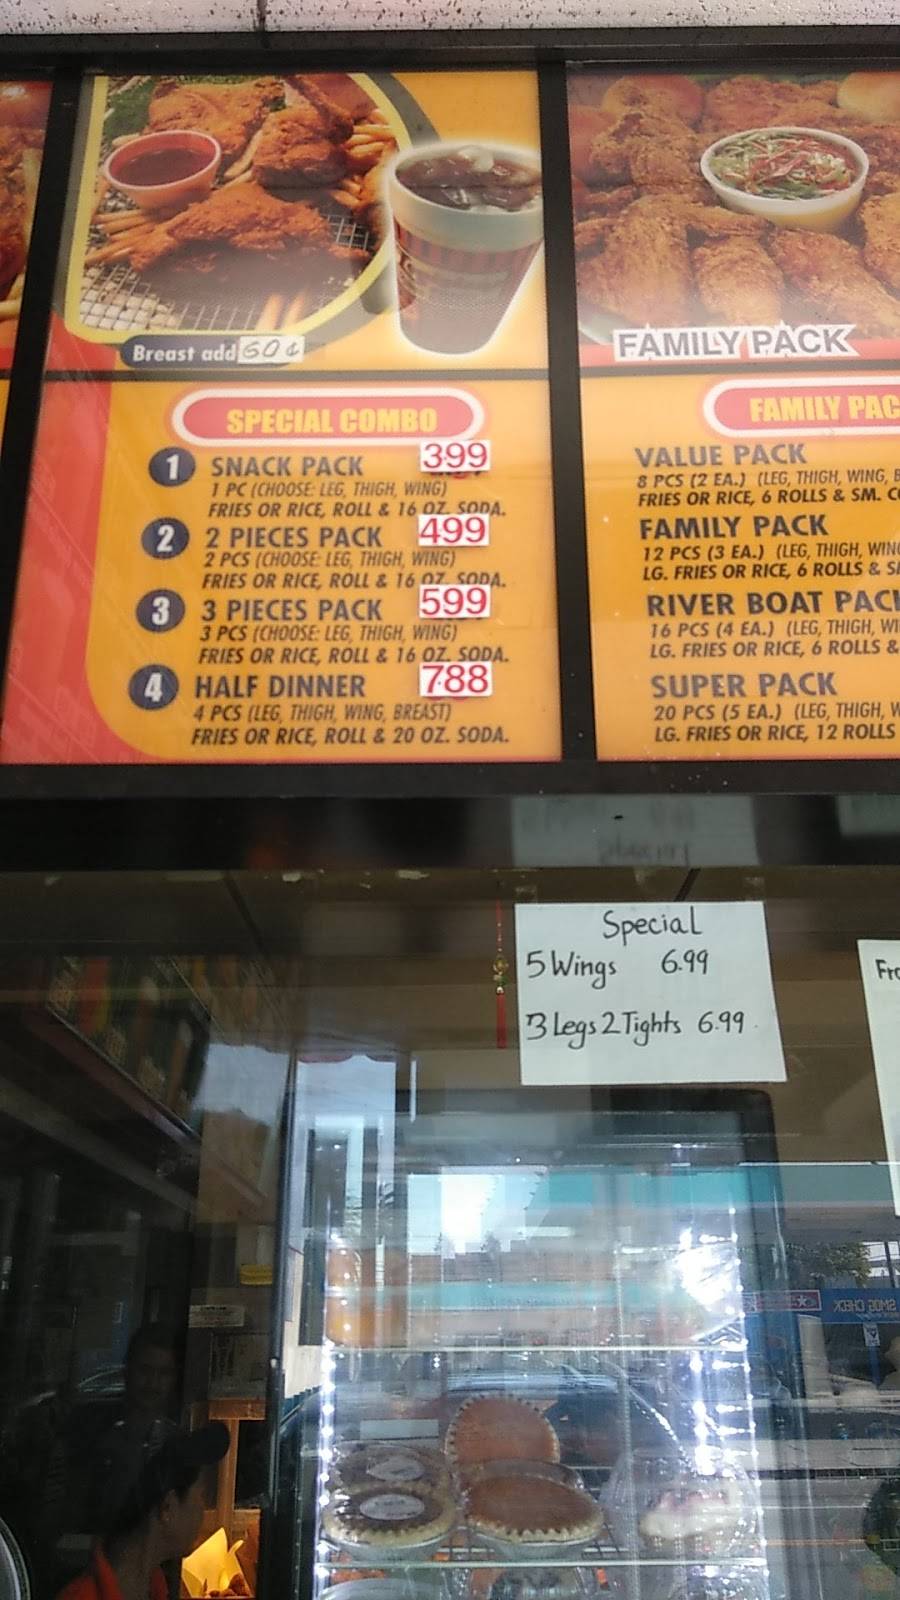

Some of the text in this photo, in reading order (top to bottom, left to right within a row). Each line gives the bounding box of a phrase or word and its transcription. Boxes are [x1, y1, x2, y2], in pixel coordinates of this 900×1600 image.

[133, 344, 236, 361] Breast add
[618, 329, 849, 357] FAMILY PACK
[751, 396, 841, 422] FAMILY
[227, 408, 438, 434] SPECIAL COMBO
[165, 455, 181, 479] 1
[635, 443, 807, 469] VALUE PACK
[211, 457, 363, 478] SNACK PACK
[226, 481, 447, 499] PC (CHOOSE: LEG, THIGH, WING)
[637, 469, 888, 489] 8 PCS (2 EA.) (LEG, THIGH, WING,
[638, 488, 881, 506] FRIES OR RICE, ROLLS & SM.
[208, 501, 506, 519] FRIES OR RICE, ROLL & 16 SODA.
[206, 526, 382, 548] 2 PIECES PACK
[640, 514, 828, 540] FAMILY PACK
[158, 526, 173, 552] 2
[216, 551, 456, 569] PCS (CHOOSE: LEG, THIGH, WING)
[645, 542, 862, 562] 12 PCS (3 EA.) (LEG, THIGH,
[202, 573, 247, 589] FRIES
[253, 573, 279, 589] OR
[282, 573, 321, 590] RICE,
[329, 573, 369, 588] ROLL
[375, 573, 387, 588] &
[397, 573, 415, 588] 16
[643, 562, 880, 581] LG. FRIES OR RICE, ROLLS &
[152, 598, 170, 624] 3
[202, 599, 382, 622] 3 PIECES PACK
[647, 591, 823, 616] RIVER BOAT
[200, 623, 457, 644] 3 PCS (CHOOSE: LEG, THIGH, WING)
[652, 619, 875, 639] 16 PCS (4 EA.) (LEG, THIGH,
[198, 648, 244, 664] FRIES
[250, 648, 274, 664] OR
[280, 647, 320, 666] RICE,
[328, 647, 368, 663] ROLL
[376, 648, 387, 664] &
[398, 647, 415, 663] 16
[458, 646, 509, 662] SODA.
[650, 639, 899, 658] LG. FRIES OR RICE, 6 ROLLS &
[144, 673, 163, 702] 4
[195, 675, 365, 698] HALF DINNER
[651, 672, 837, 699] SUPER PACK
[193, 702, 451, 724] 4 PCS (LEG, THIGH, WING, BREAST)
[654, 702, 884, 722] 20 PCS (5 EA.) (LEG, THIGH,
[192, 726, 509, 746] FRIES OR RICE, ROLL & 20 OZ. SODA.
[655, 723, 895, 743] LG. FRIES OR RICE, 12 ROLLS
[603, 906, 702, 946] Special
[527, 949, 708, 989] 5 Wings 6.99
[554, 1012, 596, 1049] Legs
[602, 1012, 620, 1034] 2
[622, 1010, 681, 1046] Tights
[698, 1010, 744, 1033] 6.99
